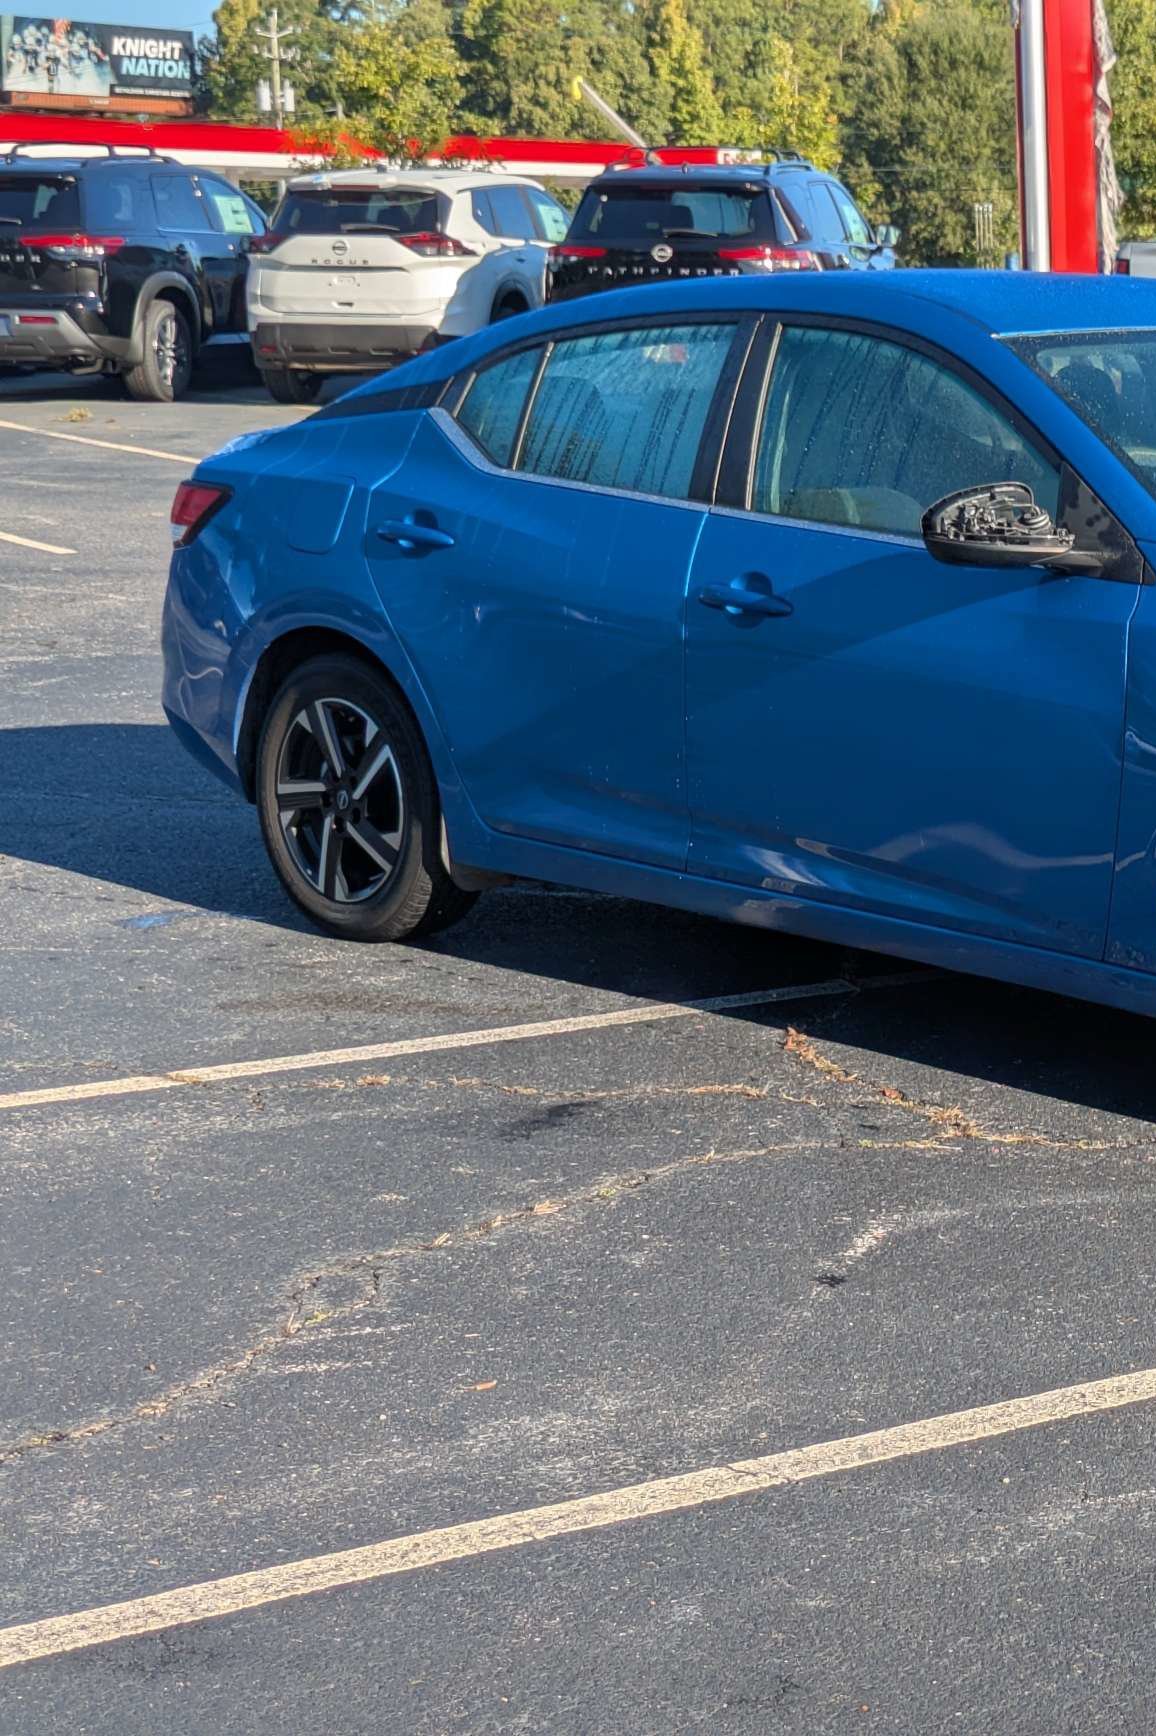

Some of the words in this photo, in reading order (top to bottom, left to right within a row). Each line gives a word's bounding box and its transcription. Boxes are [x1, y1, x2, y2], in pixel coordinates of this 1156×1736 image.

[112, 36, 183, 59] KNIGHT
[121, 57, 190, 79] NATION
[587, 265, 740, 277] PATHFINDER
